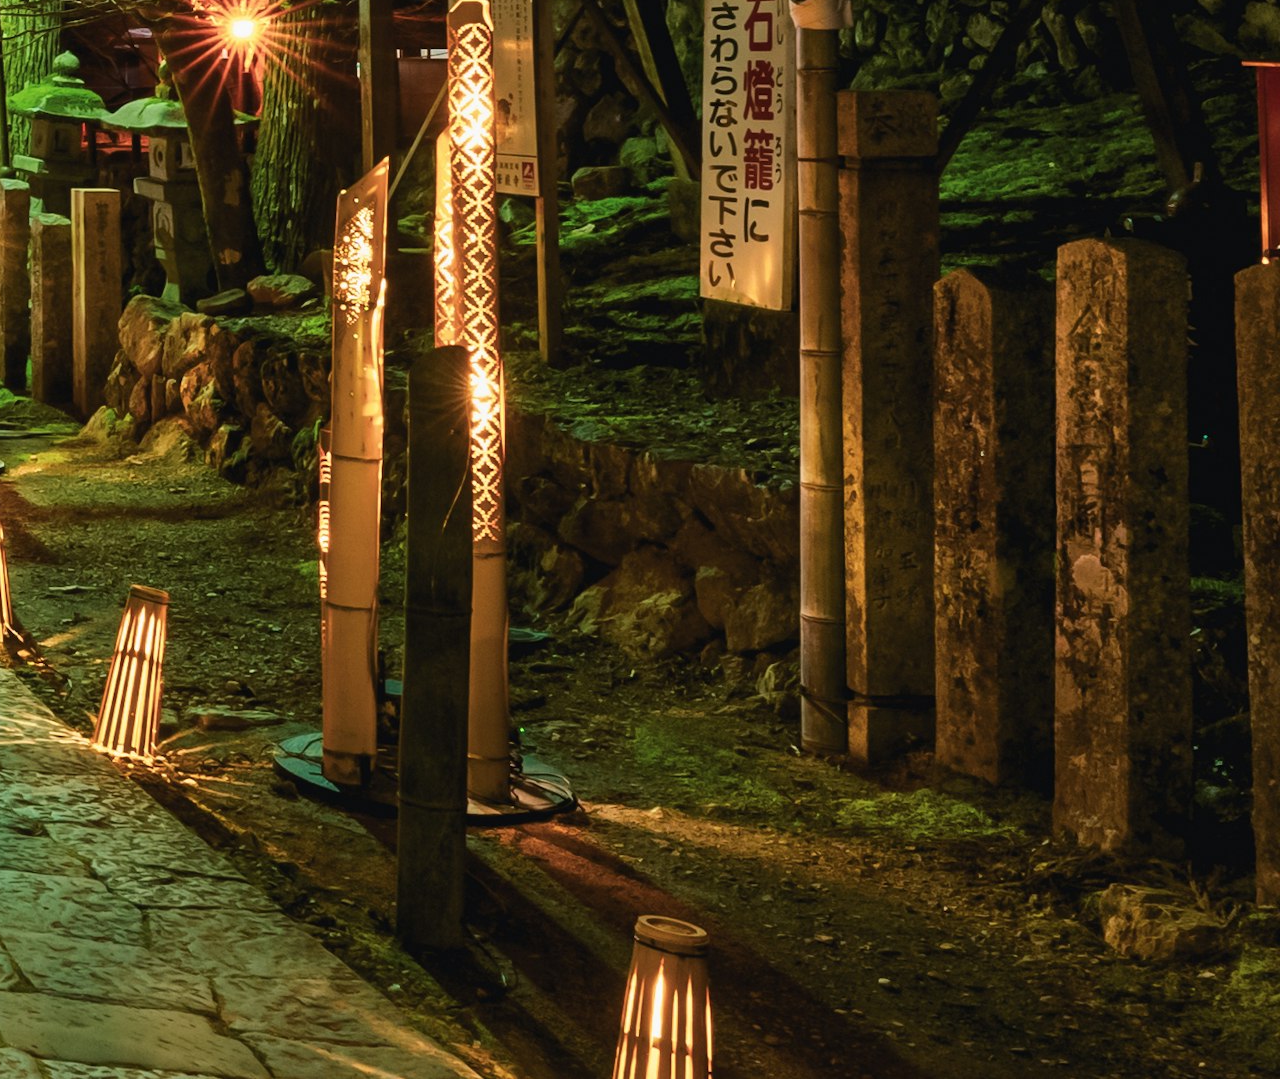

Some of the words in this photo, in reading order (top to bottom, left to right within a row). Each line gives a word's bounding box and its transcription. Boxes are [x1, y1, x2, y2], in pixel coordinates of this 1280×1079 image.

[708, 1, 739, 288] さわらないで下さい
